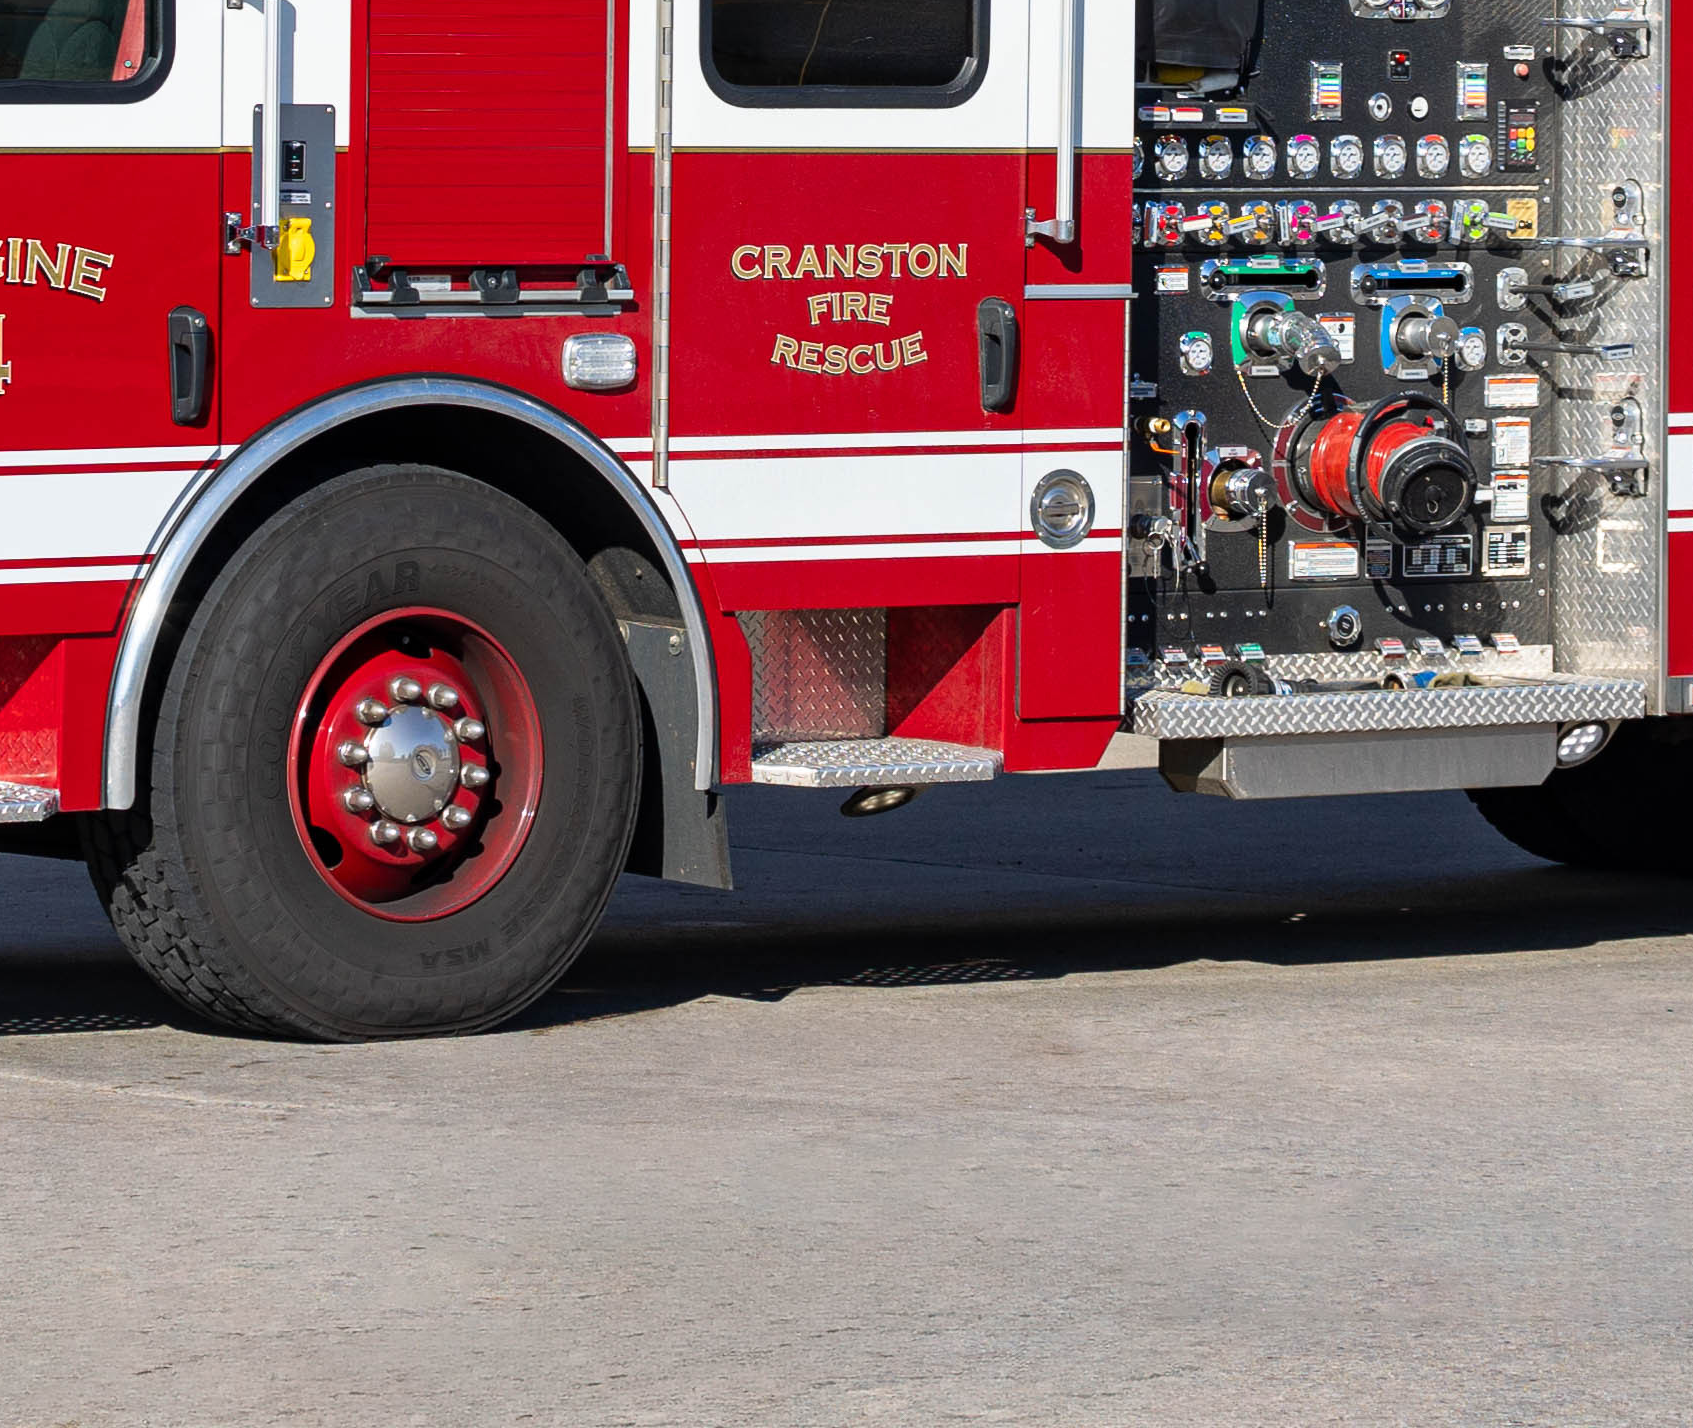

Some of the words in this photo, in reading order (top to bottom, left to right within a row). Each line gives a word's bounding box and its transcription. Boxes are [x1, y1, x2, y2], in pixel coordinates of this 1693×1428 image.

[731, 243, 968, 279] CRANSTON
[807, 291, 893, 326] FIRE
[770, 331, 927, 374] RESCUE
